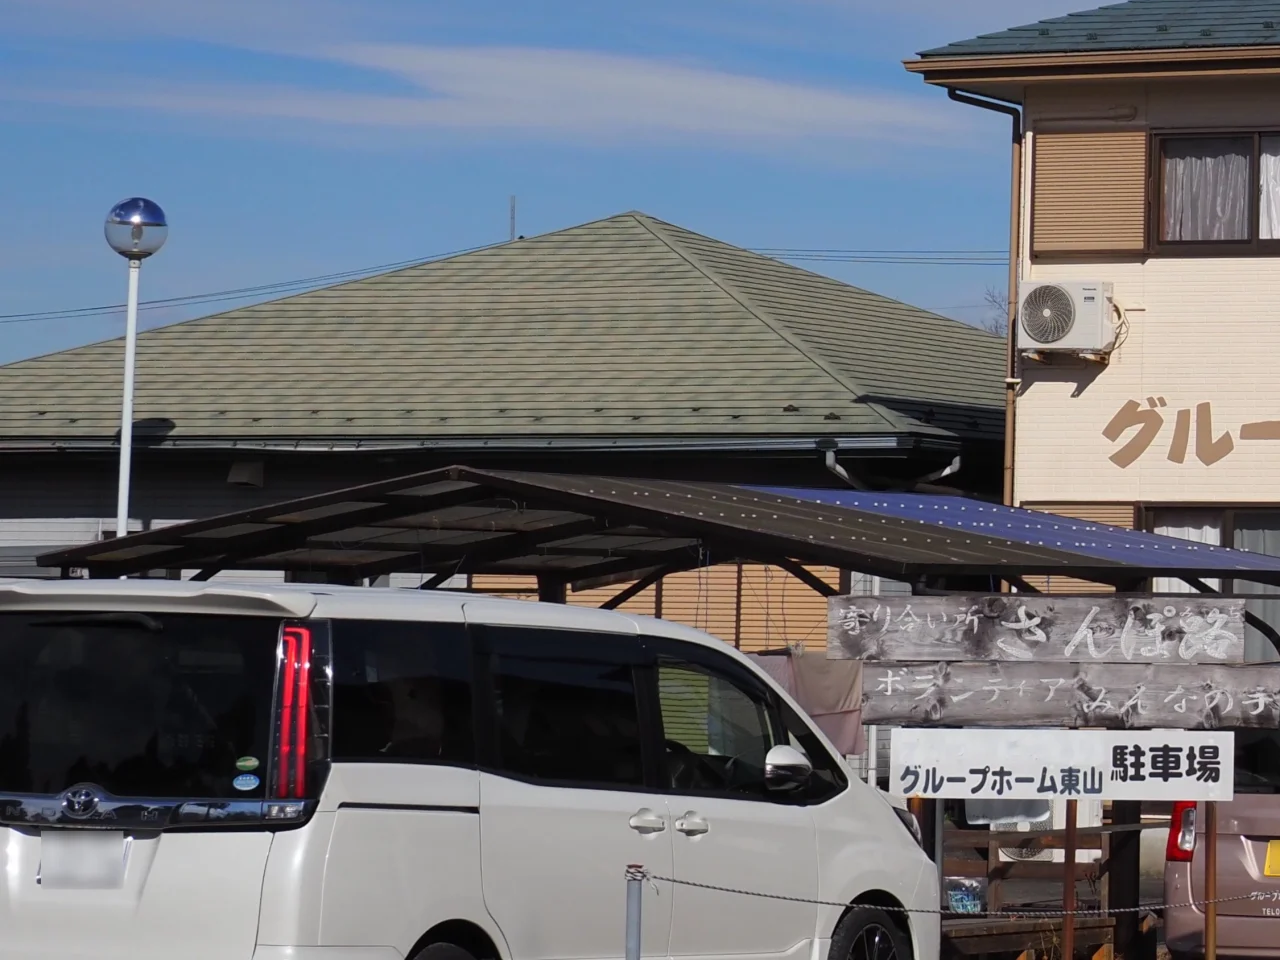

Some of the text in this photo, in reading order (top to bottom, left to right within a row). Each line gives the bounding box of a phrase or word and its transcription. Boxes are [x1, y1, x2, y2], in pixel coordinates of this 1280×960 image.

[837, 604, 984, 635] 寄り合い所
[875, 669, 1066, 704] ボランティア
[900, 743, 1222, 796] グループホーム東山 駐車場
